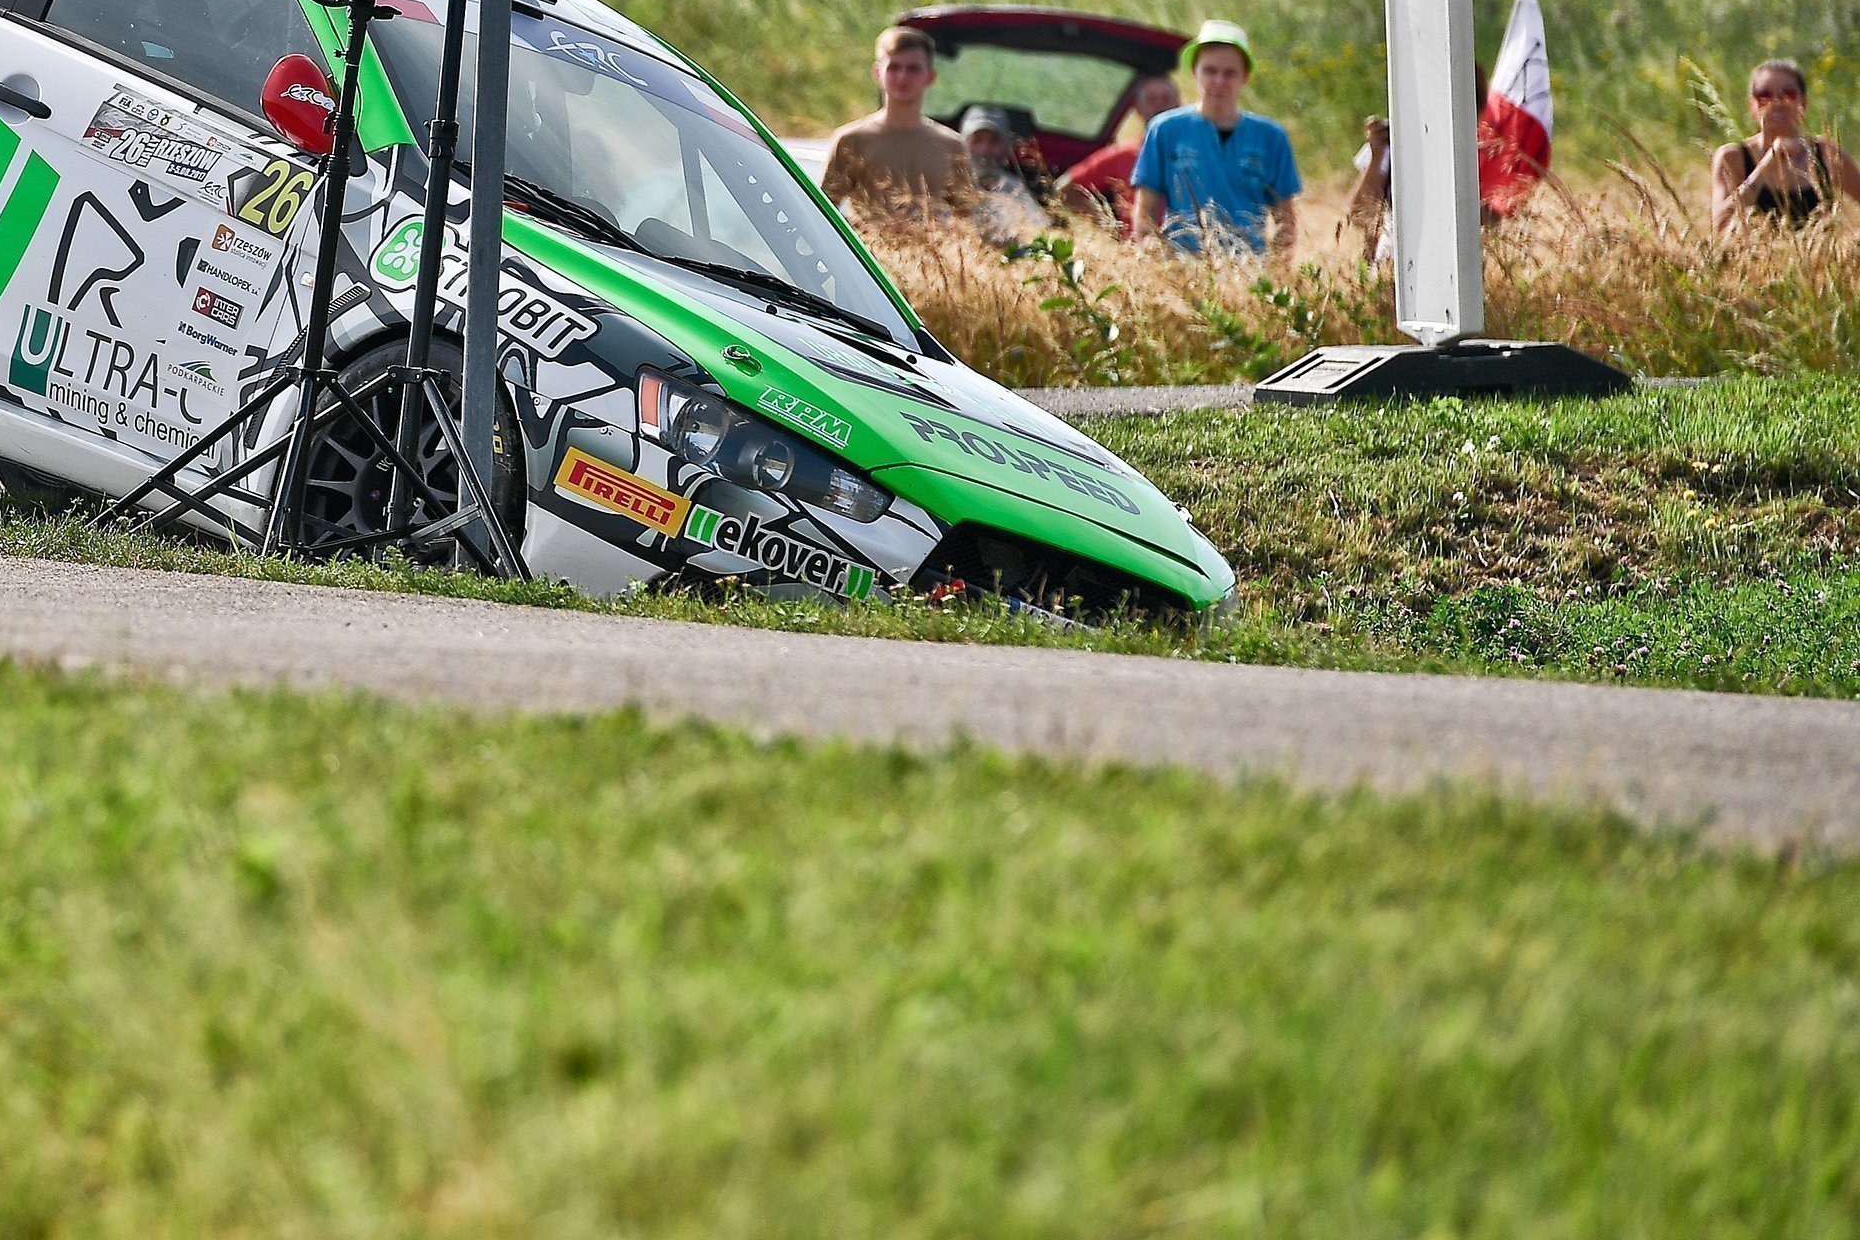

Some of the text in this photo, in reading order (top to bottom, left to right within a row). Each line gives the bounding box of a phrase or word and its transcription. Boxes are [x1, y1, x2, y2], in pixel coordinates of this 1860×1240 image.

[111, 127, 152, 164] 26
[136, 134, 161, 168] RALLY
[238, 159, 314, 233] 26
[233, 237, 272, 261] rzeszów
[206, 264, 252, 292] HANDLOPEX
[210, 307, 237, 325] CARS
[214, 298, 240, 316] INTER
[186, 324, 238, 356] BorgWarner
[167, 364, 225, 396] PODKARPACKIE
[49, 381, 109, 425] mining
[115, 401, 129, 427] &
[758, 383, 853, 445] RPM
[900, 411, 1141, 516] PROSPEED
[568, 458, 676, 525] PIRELLI
[716, 513, 848, 594] ekover
